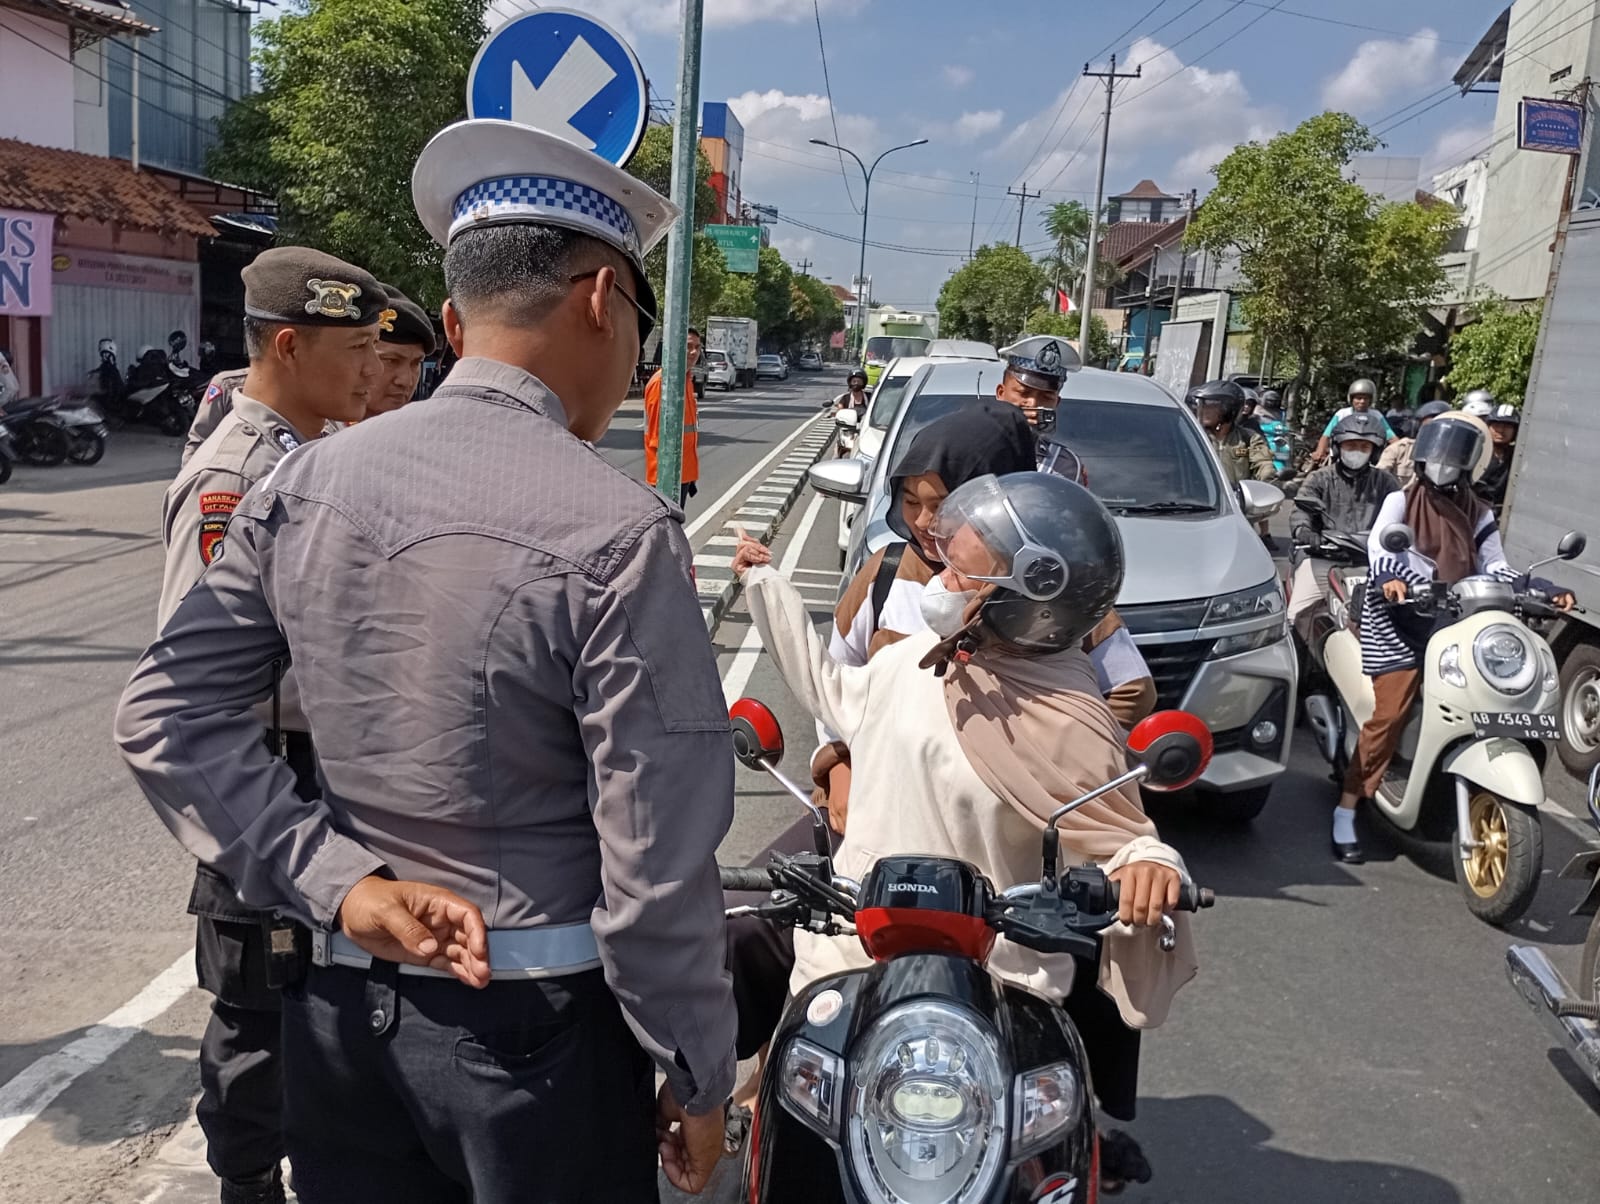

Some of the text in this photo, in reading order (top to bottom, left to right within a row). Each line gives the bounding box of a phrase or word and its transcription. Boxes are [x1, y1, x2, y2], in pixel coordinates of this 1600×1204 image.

[0, 217, 36, 258] S
[1473, 712, 1490, 725] AB
[1497, 713, 1532, 726] 4549
[888, 883, 939, 894] HONDA
